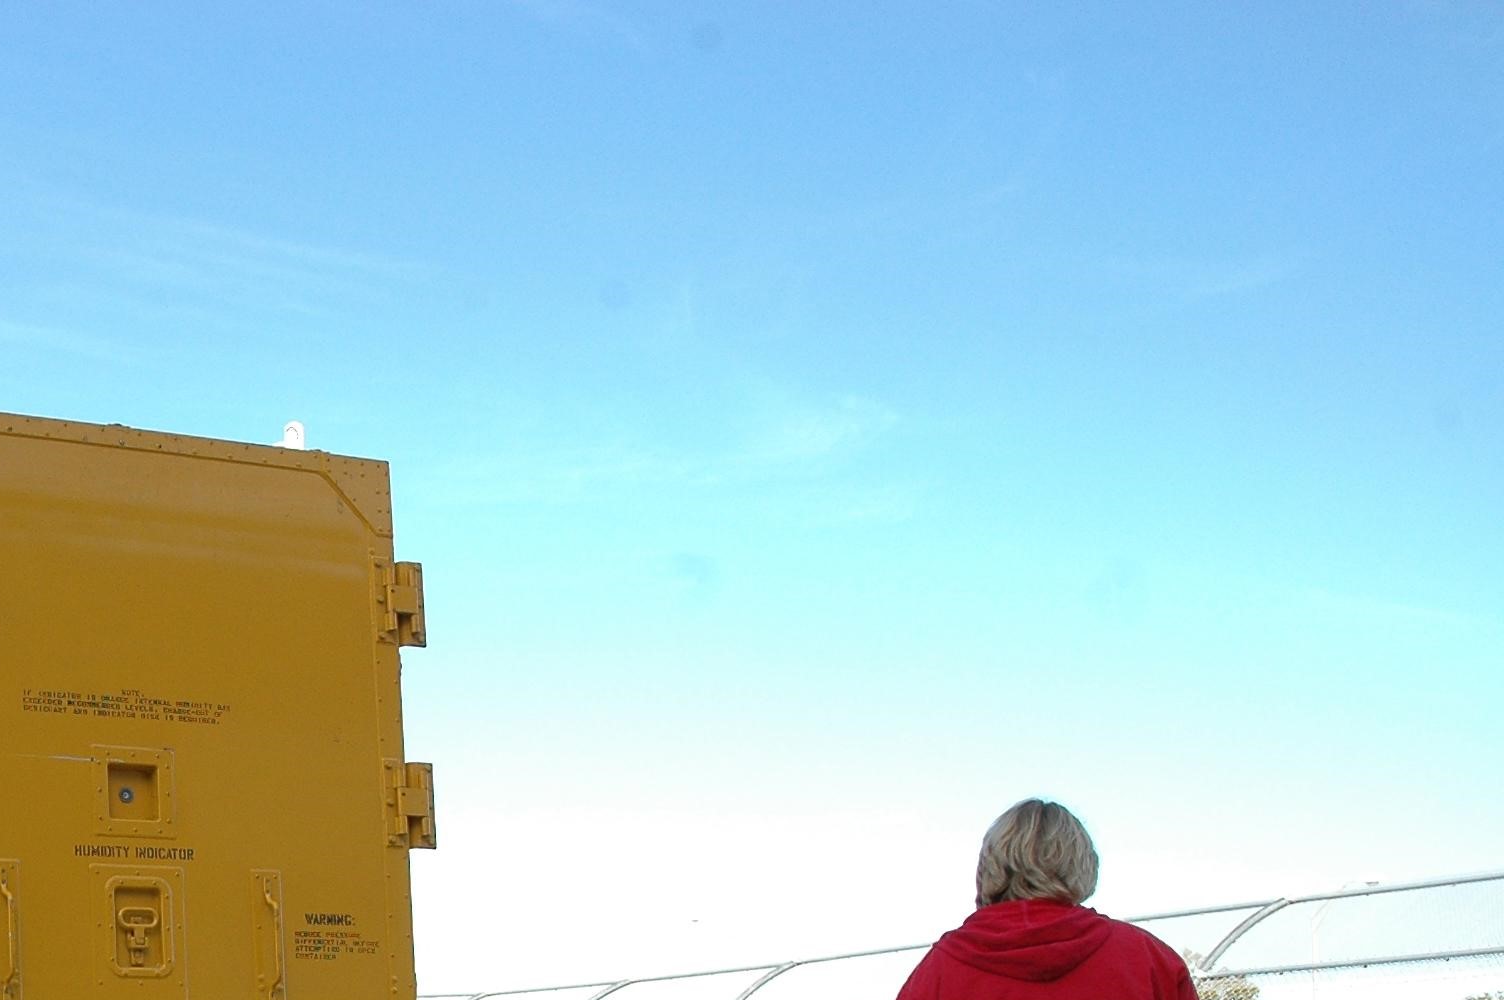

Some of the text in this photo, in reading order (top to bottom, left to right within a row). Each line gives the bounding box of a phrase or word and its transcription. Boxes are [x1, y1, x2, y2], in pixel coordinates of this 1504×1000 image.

[75, 844, 194, 861] HUMIDITY INDICATOR
[305, 913, 356, 926] WARNING:
